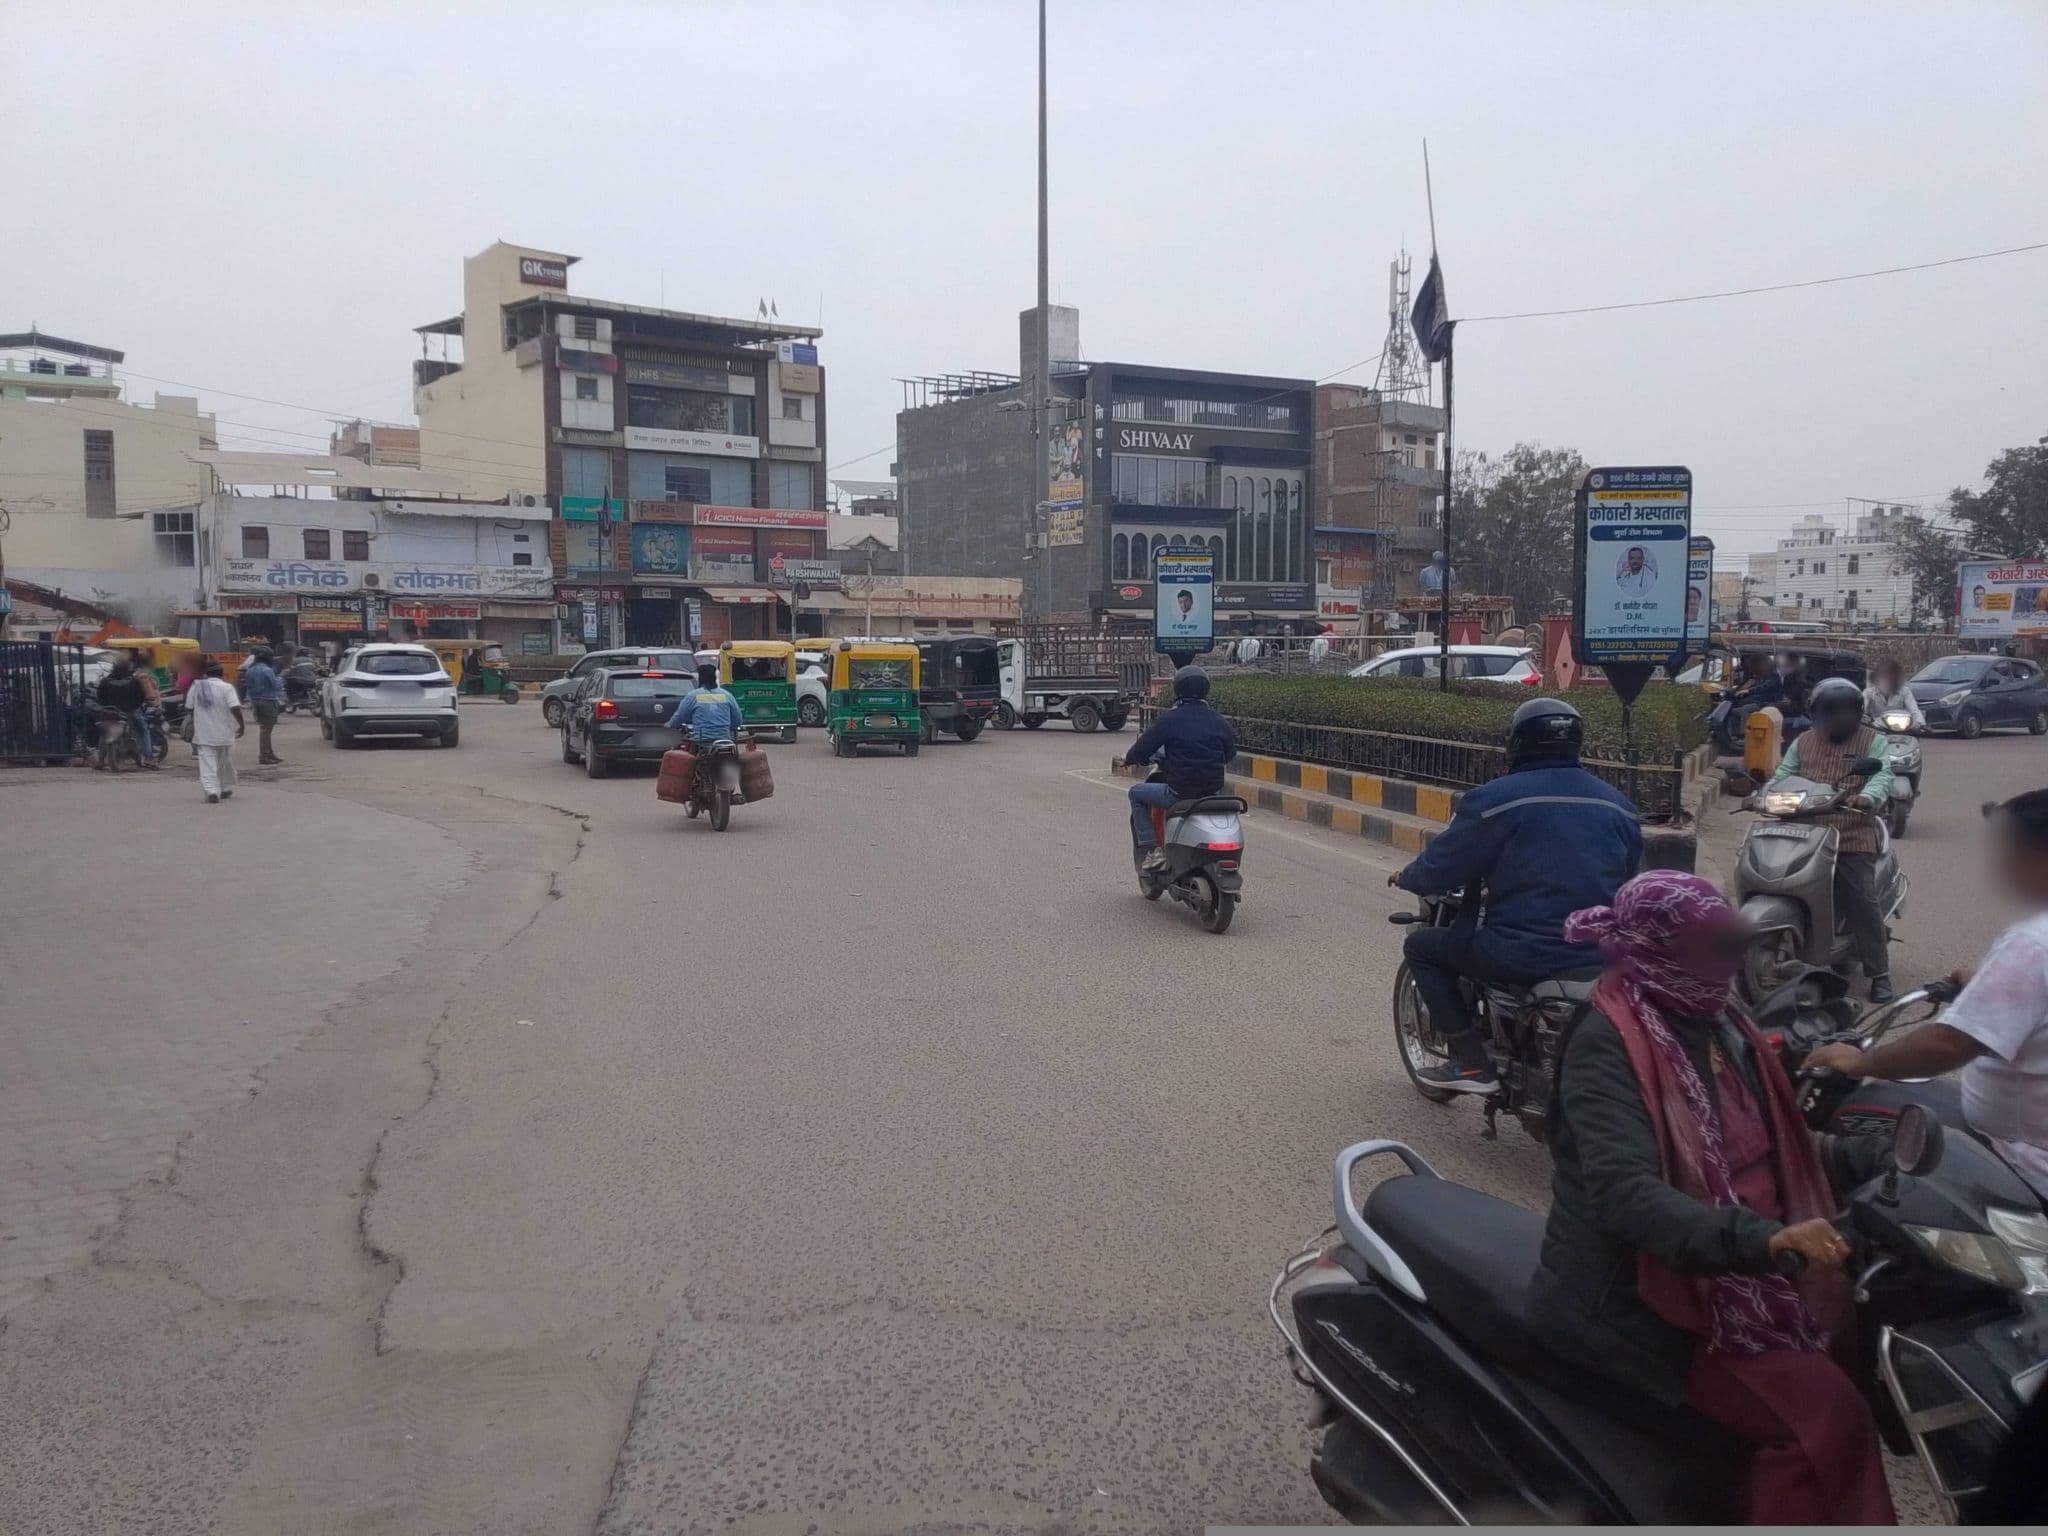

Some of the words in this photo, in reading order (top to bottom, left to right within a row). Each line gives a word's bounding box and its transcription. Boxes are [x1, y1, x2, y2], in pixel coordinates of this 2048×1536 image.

[523, 260, 543, 276] GK
[1119, 429, 1194, 450] SHIVAAY
[714, 514, 735, 522] ICICI
[736, 515, 758, 523] Home
[1588, 503, 1632, 520] कोठारी
[1633, 506, 1688, 520] अस्पताल
[267, 563, 349, 589] दैनिक
[394, 567, 481, 590] लोकमत
[786, 568, 840, 579] PARSHWANATH
[1985, 565, 2024, 580] कोठारी
